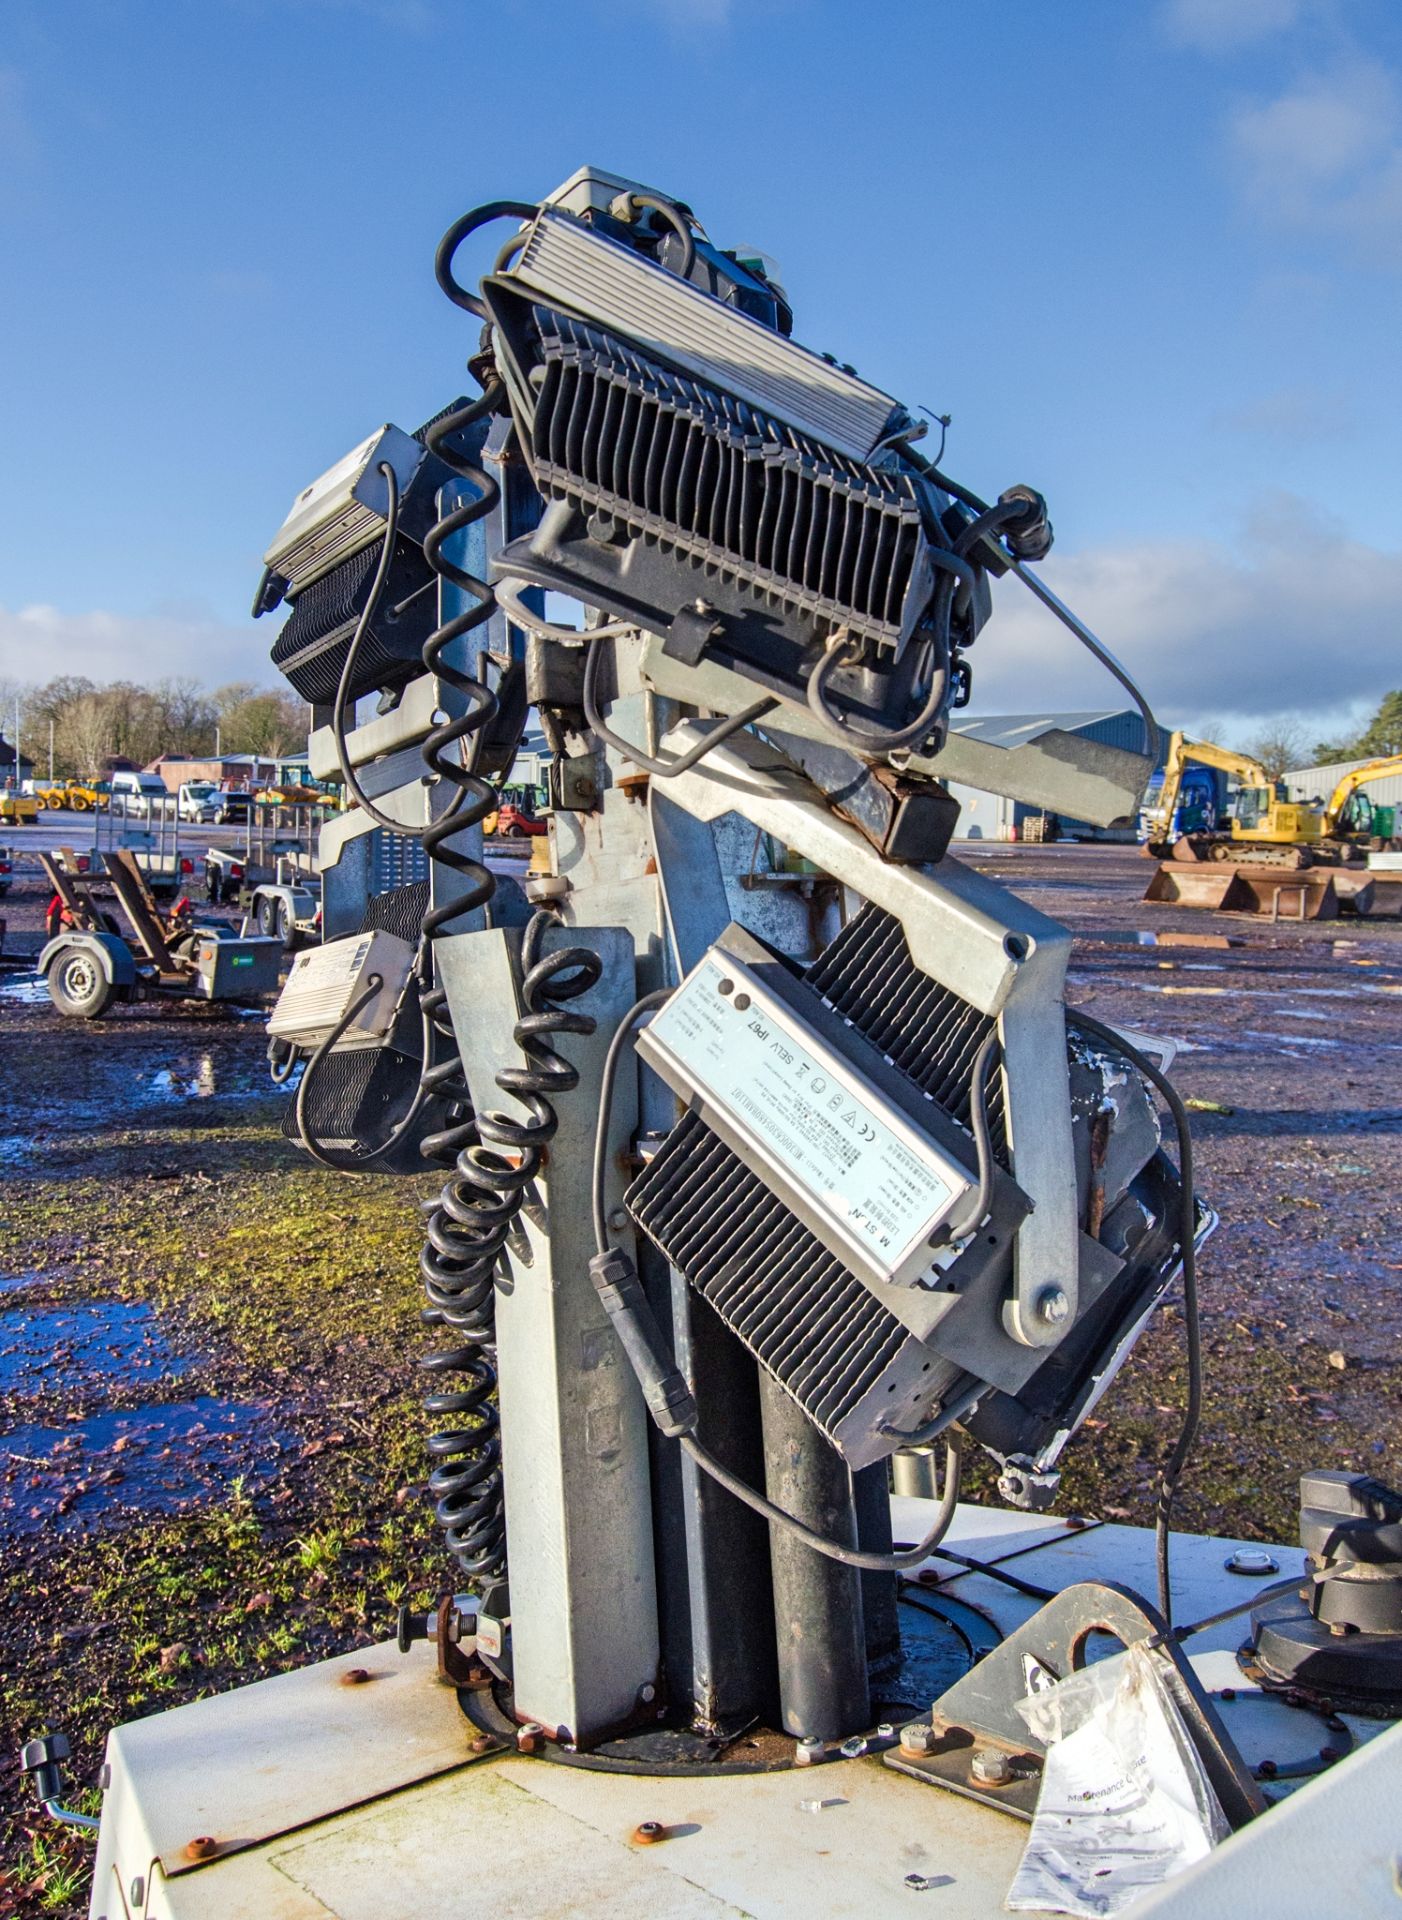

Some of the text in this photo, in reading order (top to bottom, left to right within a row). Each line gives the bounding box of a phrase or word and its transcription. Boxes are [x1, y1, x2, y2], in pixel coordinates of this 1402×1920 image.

[746, 1017, 770, 1042] IP67
[768, 1039, 795, 1066] SELV
[849, 1206, 892, 1249] MSTN
